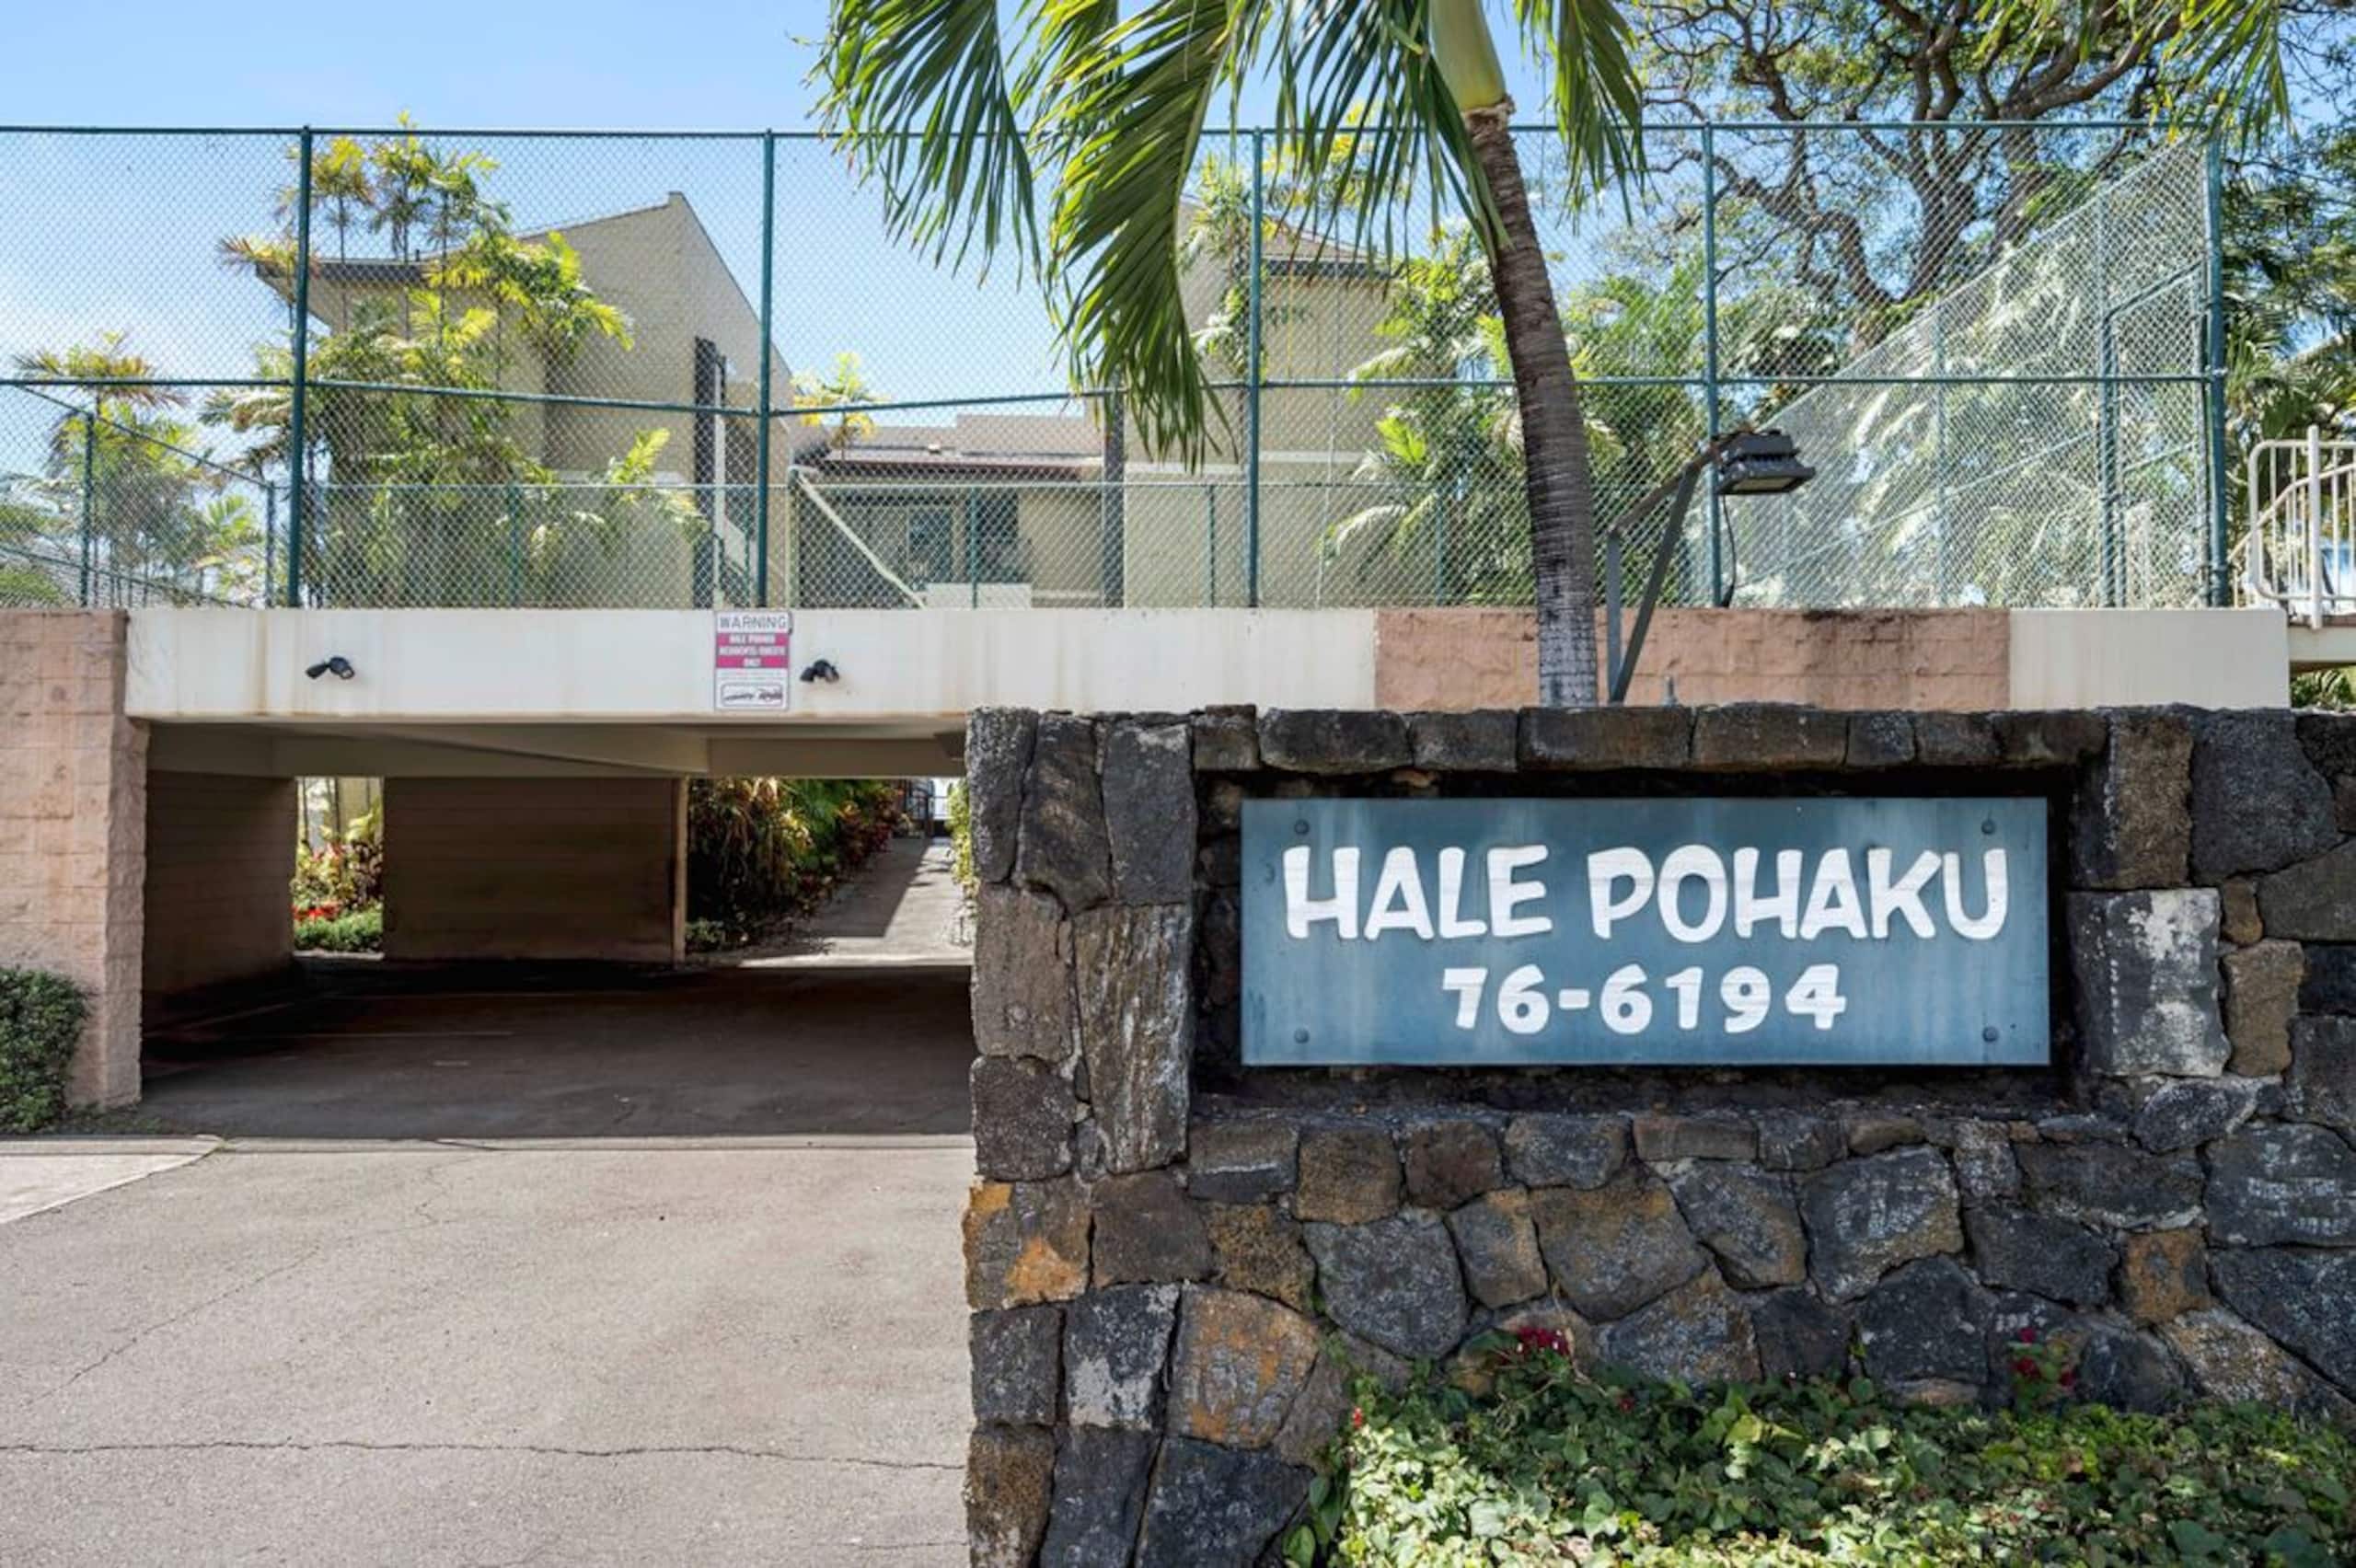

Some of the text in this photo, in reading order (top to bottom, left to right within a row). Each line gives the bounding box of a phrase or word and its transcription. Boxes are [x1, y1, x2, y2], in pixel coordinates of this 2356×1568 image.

[720, 616, 787, 628] WARNING
[1283, 844, 2008, 943] HALE POHAKU
[1442, 963, 1847, 1034] 76-6194
